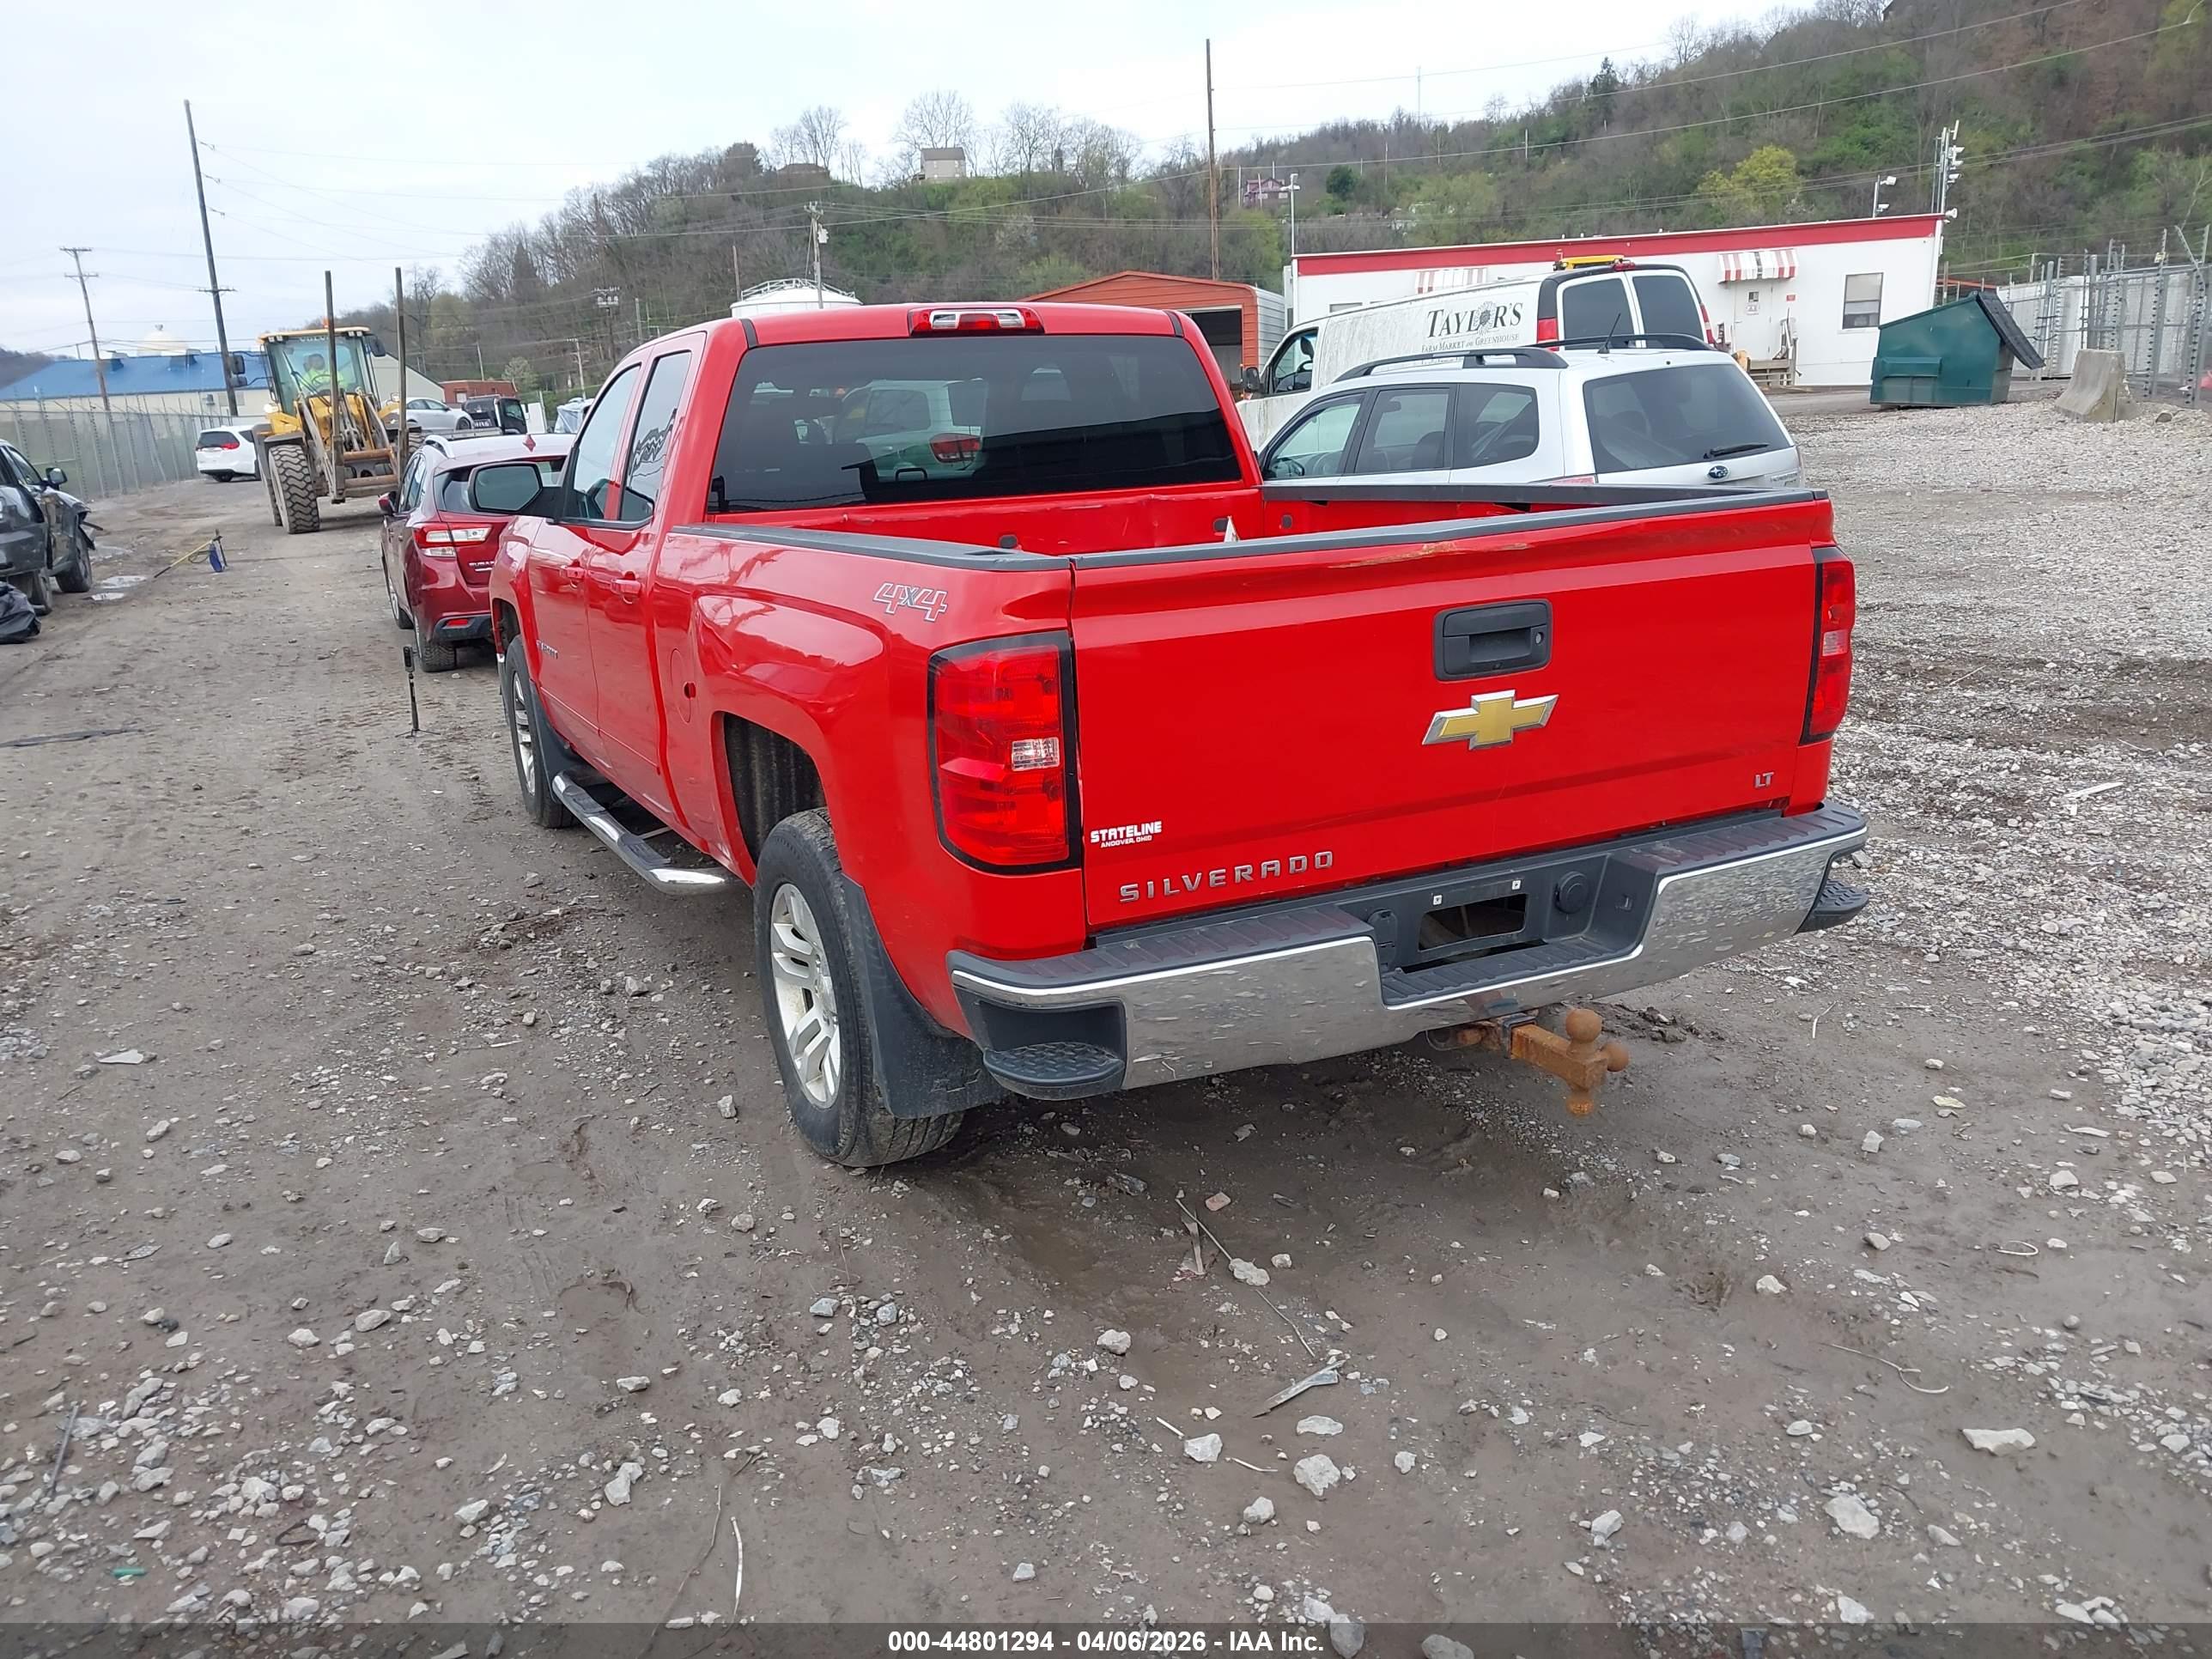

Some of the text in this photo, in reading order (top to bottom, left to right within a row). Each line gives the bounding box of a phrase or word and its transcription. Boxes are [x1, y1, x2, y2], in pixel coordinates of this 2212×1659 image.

[1439, 341, 1465, 350] MARKET
[1476, 333, 1519, 346] GREENHOUSE
[1755, 771, 1774, 788] LT
[1090, 820, 1162, 843] STATELINE
[1135, 834, 1152, 843] OHIO
[1120, 850, 1333, 902] SILVERADO
